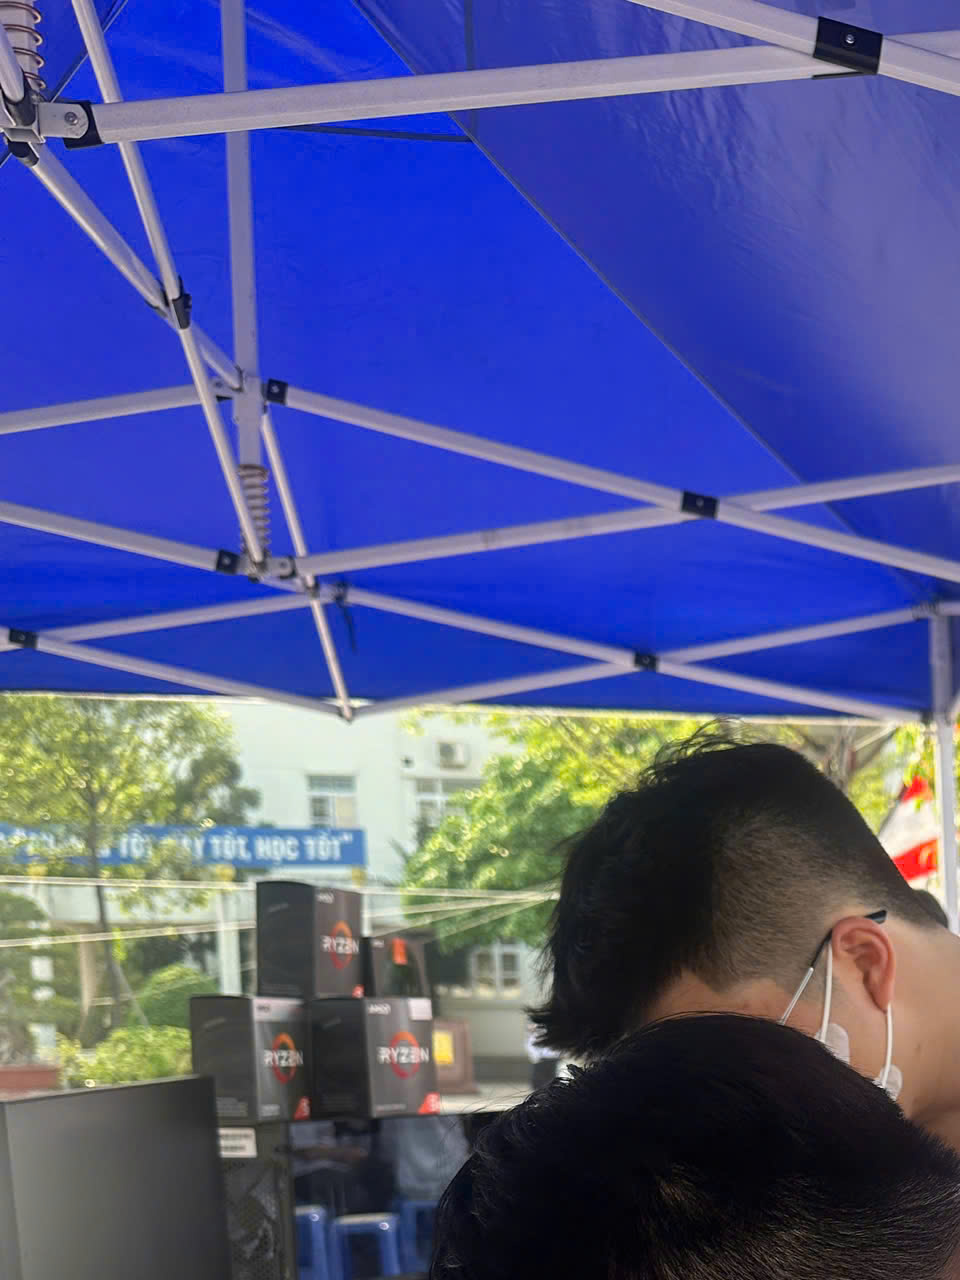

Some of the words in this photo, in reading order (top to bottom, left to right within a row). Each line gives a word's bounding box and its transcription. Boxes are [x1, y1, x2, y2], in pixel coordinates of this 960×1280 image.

[322, 936, 360, 954] RYZEN
[264, 1049, 304, 1068] RYZEN
[377, 1046, 430, 1065] RYZEN
